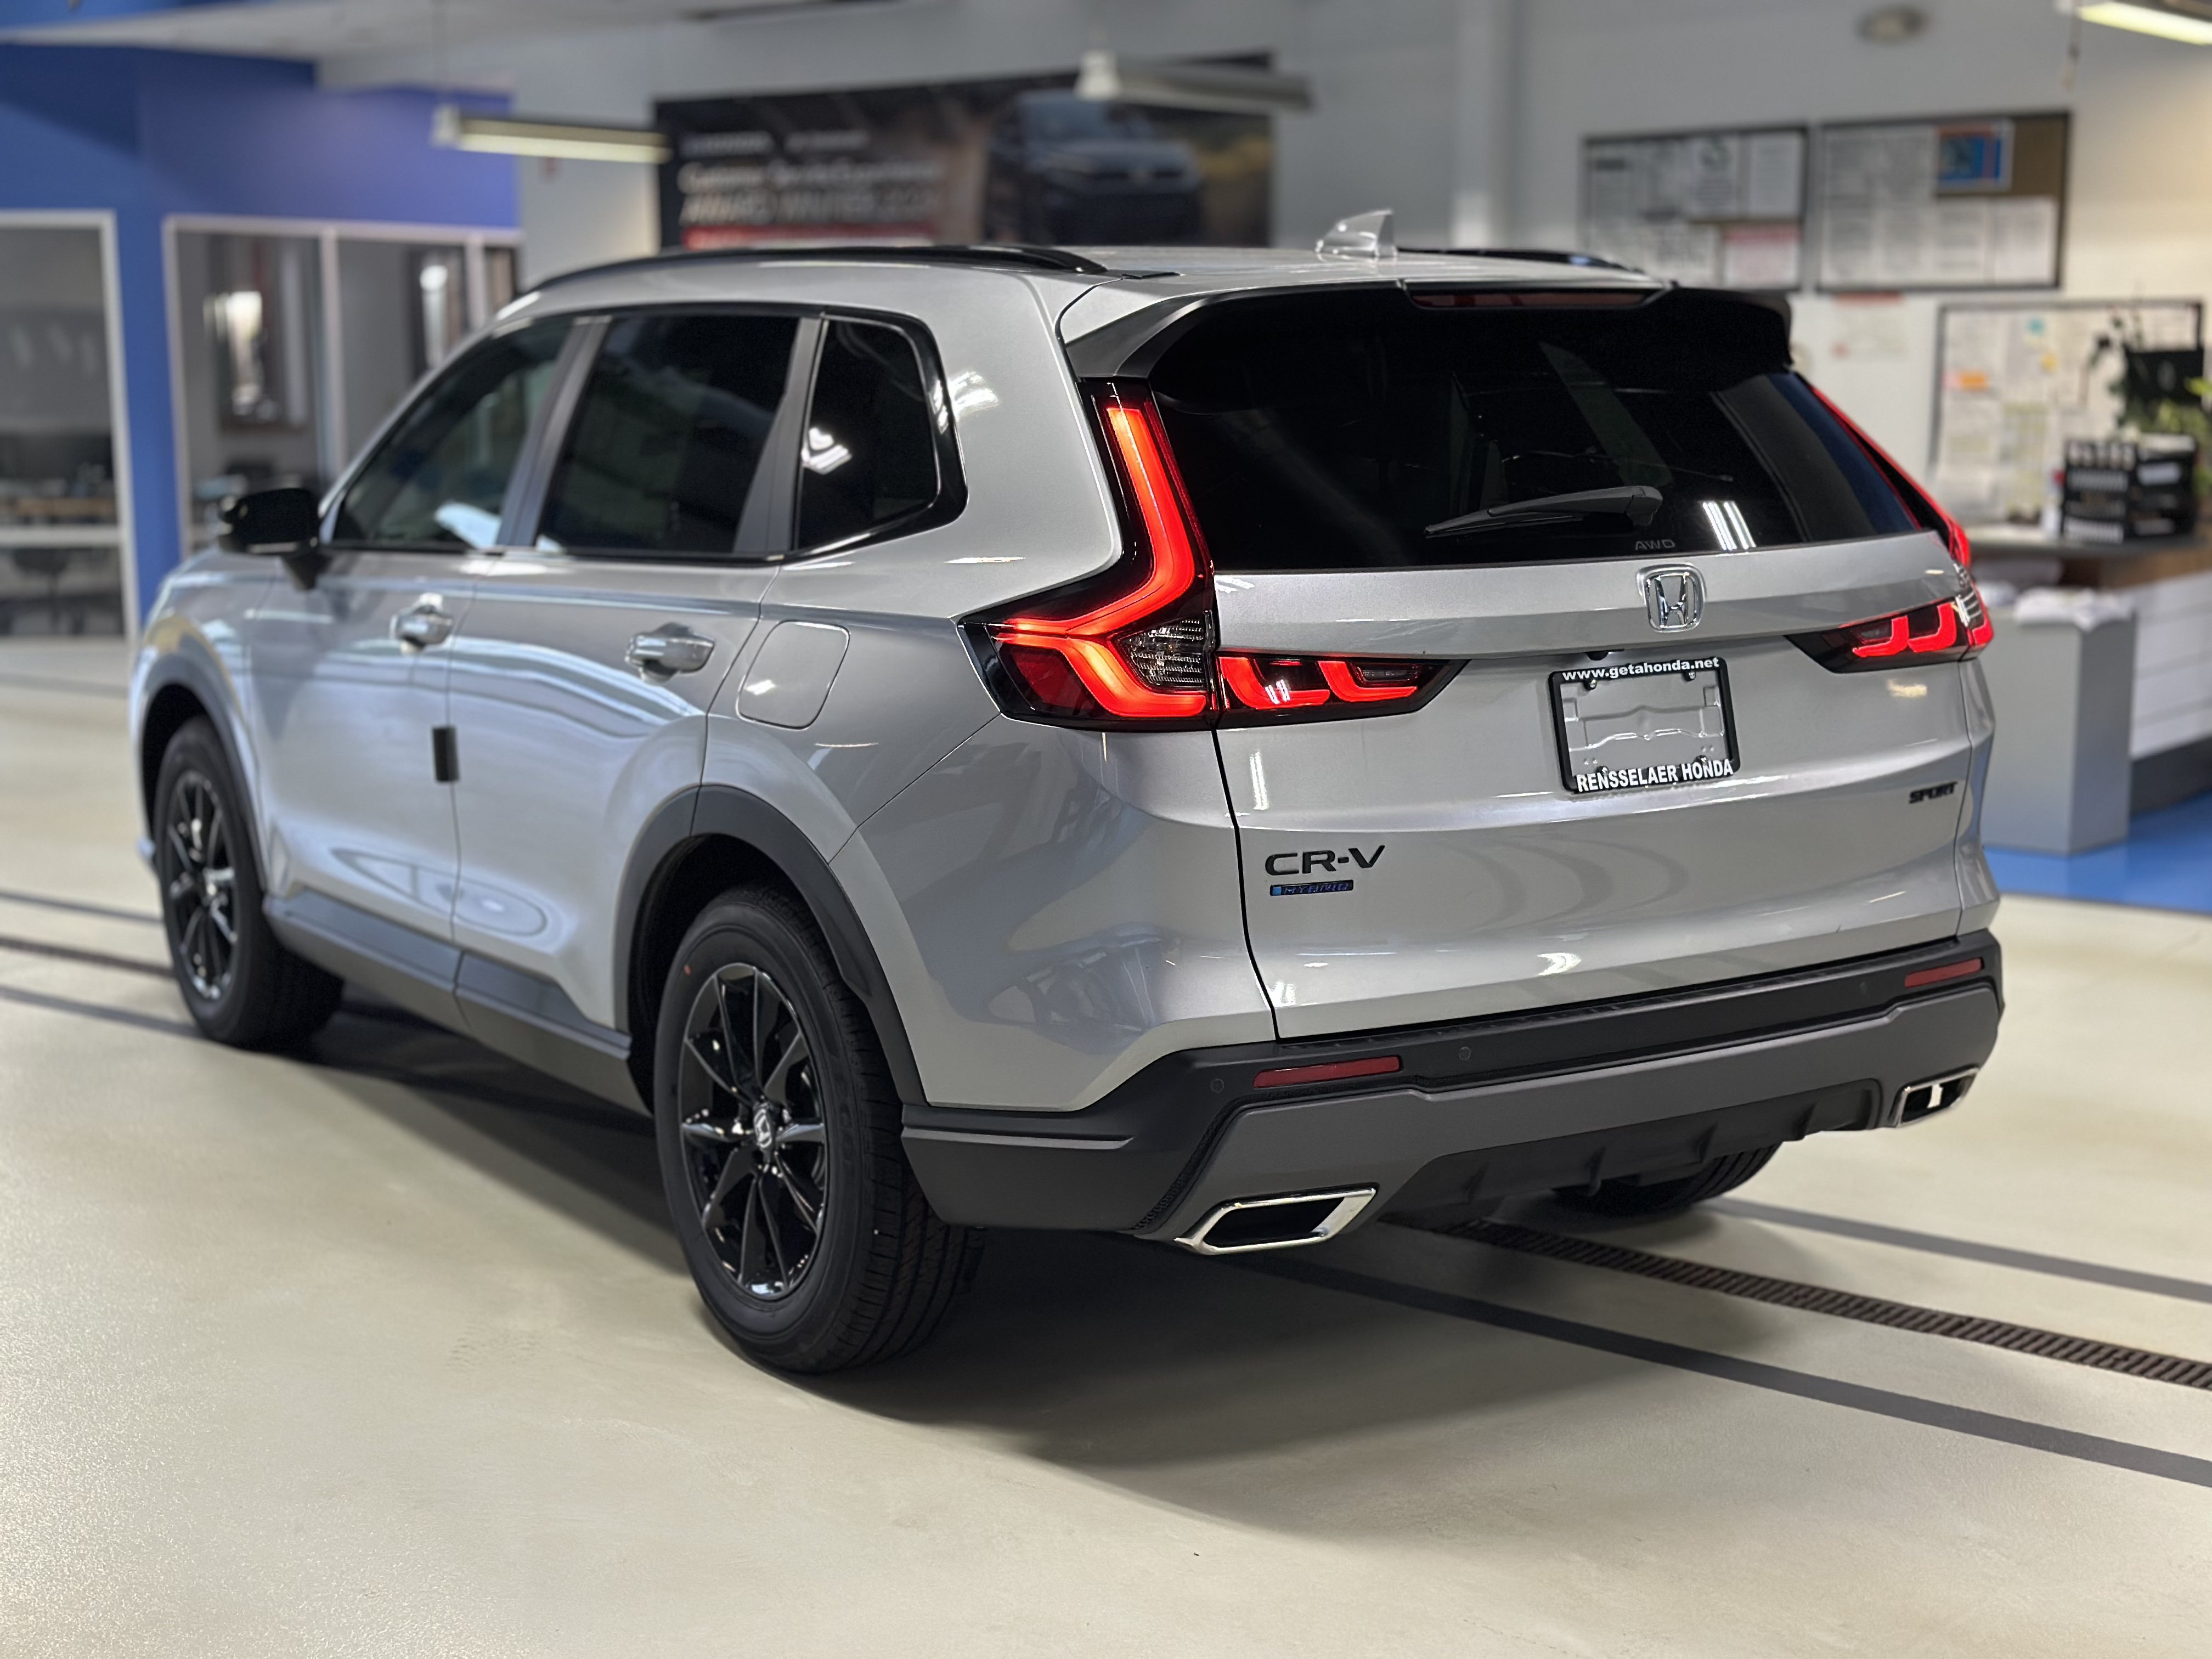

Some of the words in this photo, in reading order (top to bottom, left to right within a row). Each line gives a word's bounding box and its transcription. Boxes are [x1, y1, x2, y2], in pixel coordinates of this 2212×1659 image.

[1635, 539, 1676, 551] AWD
[1562, 657, 1719, 680] www.getahonda.net
[1576, 765, 1679, 792] RENSSELAER
[1681, 759, 1734, 781] HONDA
[1909, 781, 1957, 804] SPORT
[1265, 845, 1385, 876] CR-V
